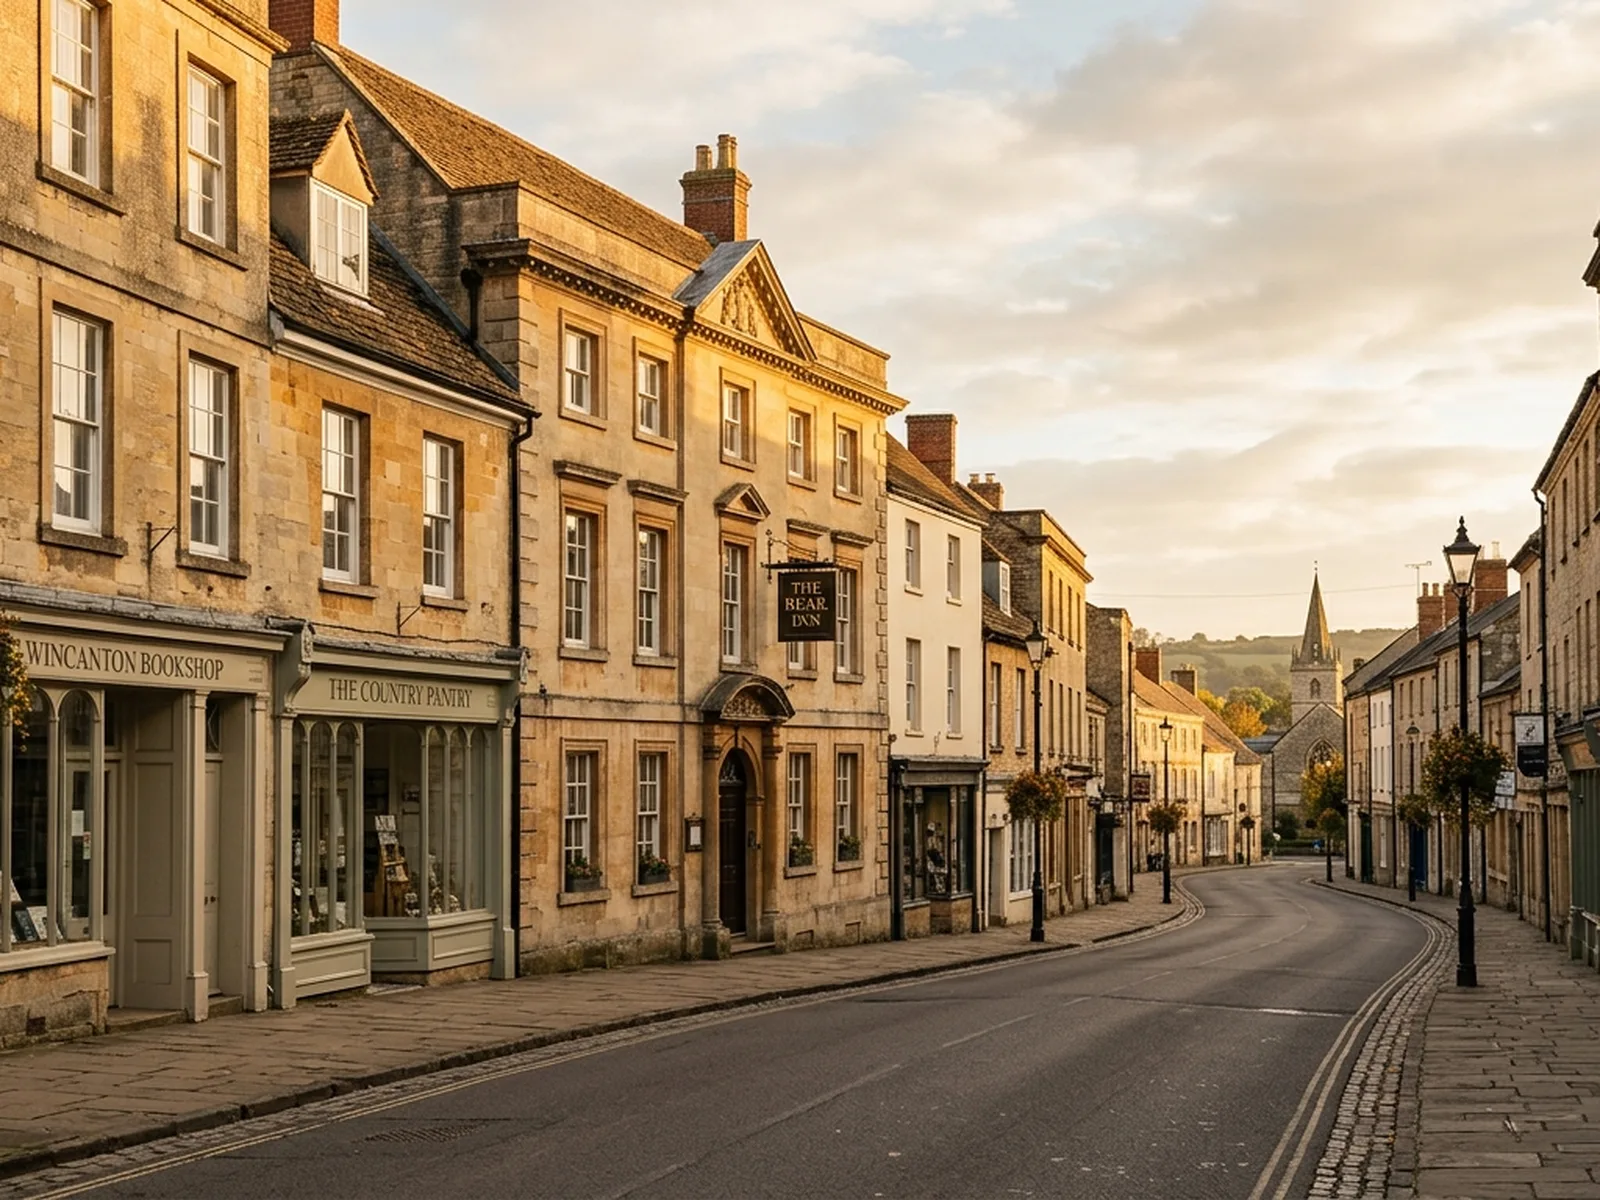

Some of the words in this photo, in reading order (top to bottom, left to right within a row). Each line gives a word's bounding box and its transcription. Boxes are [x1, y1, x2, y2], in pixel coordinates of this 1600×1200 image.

[791, 581, 822, 595] THE
[784, 596, 829, 611] BEAR
[25, 640, 136, 674] WINCANTON
[140, 652, 224, 680] BOOKSHOP
[329, 677, 357, 701] THE
[360, 680, 424, 704] COUNTRY
[427, 686, 473, 708] PANTRY
